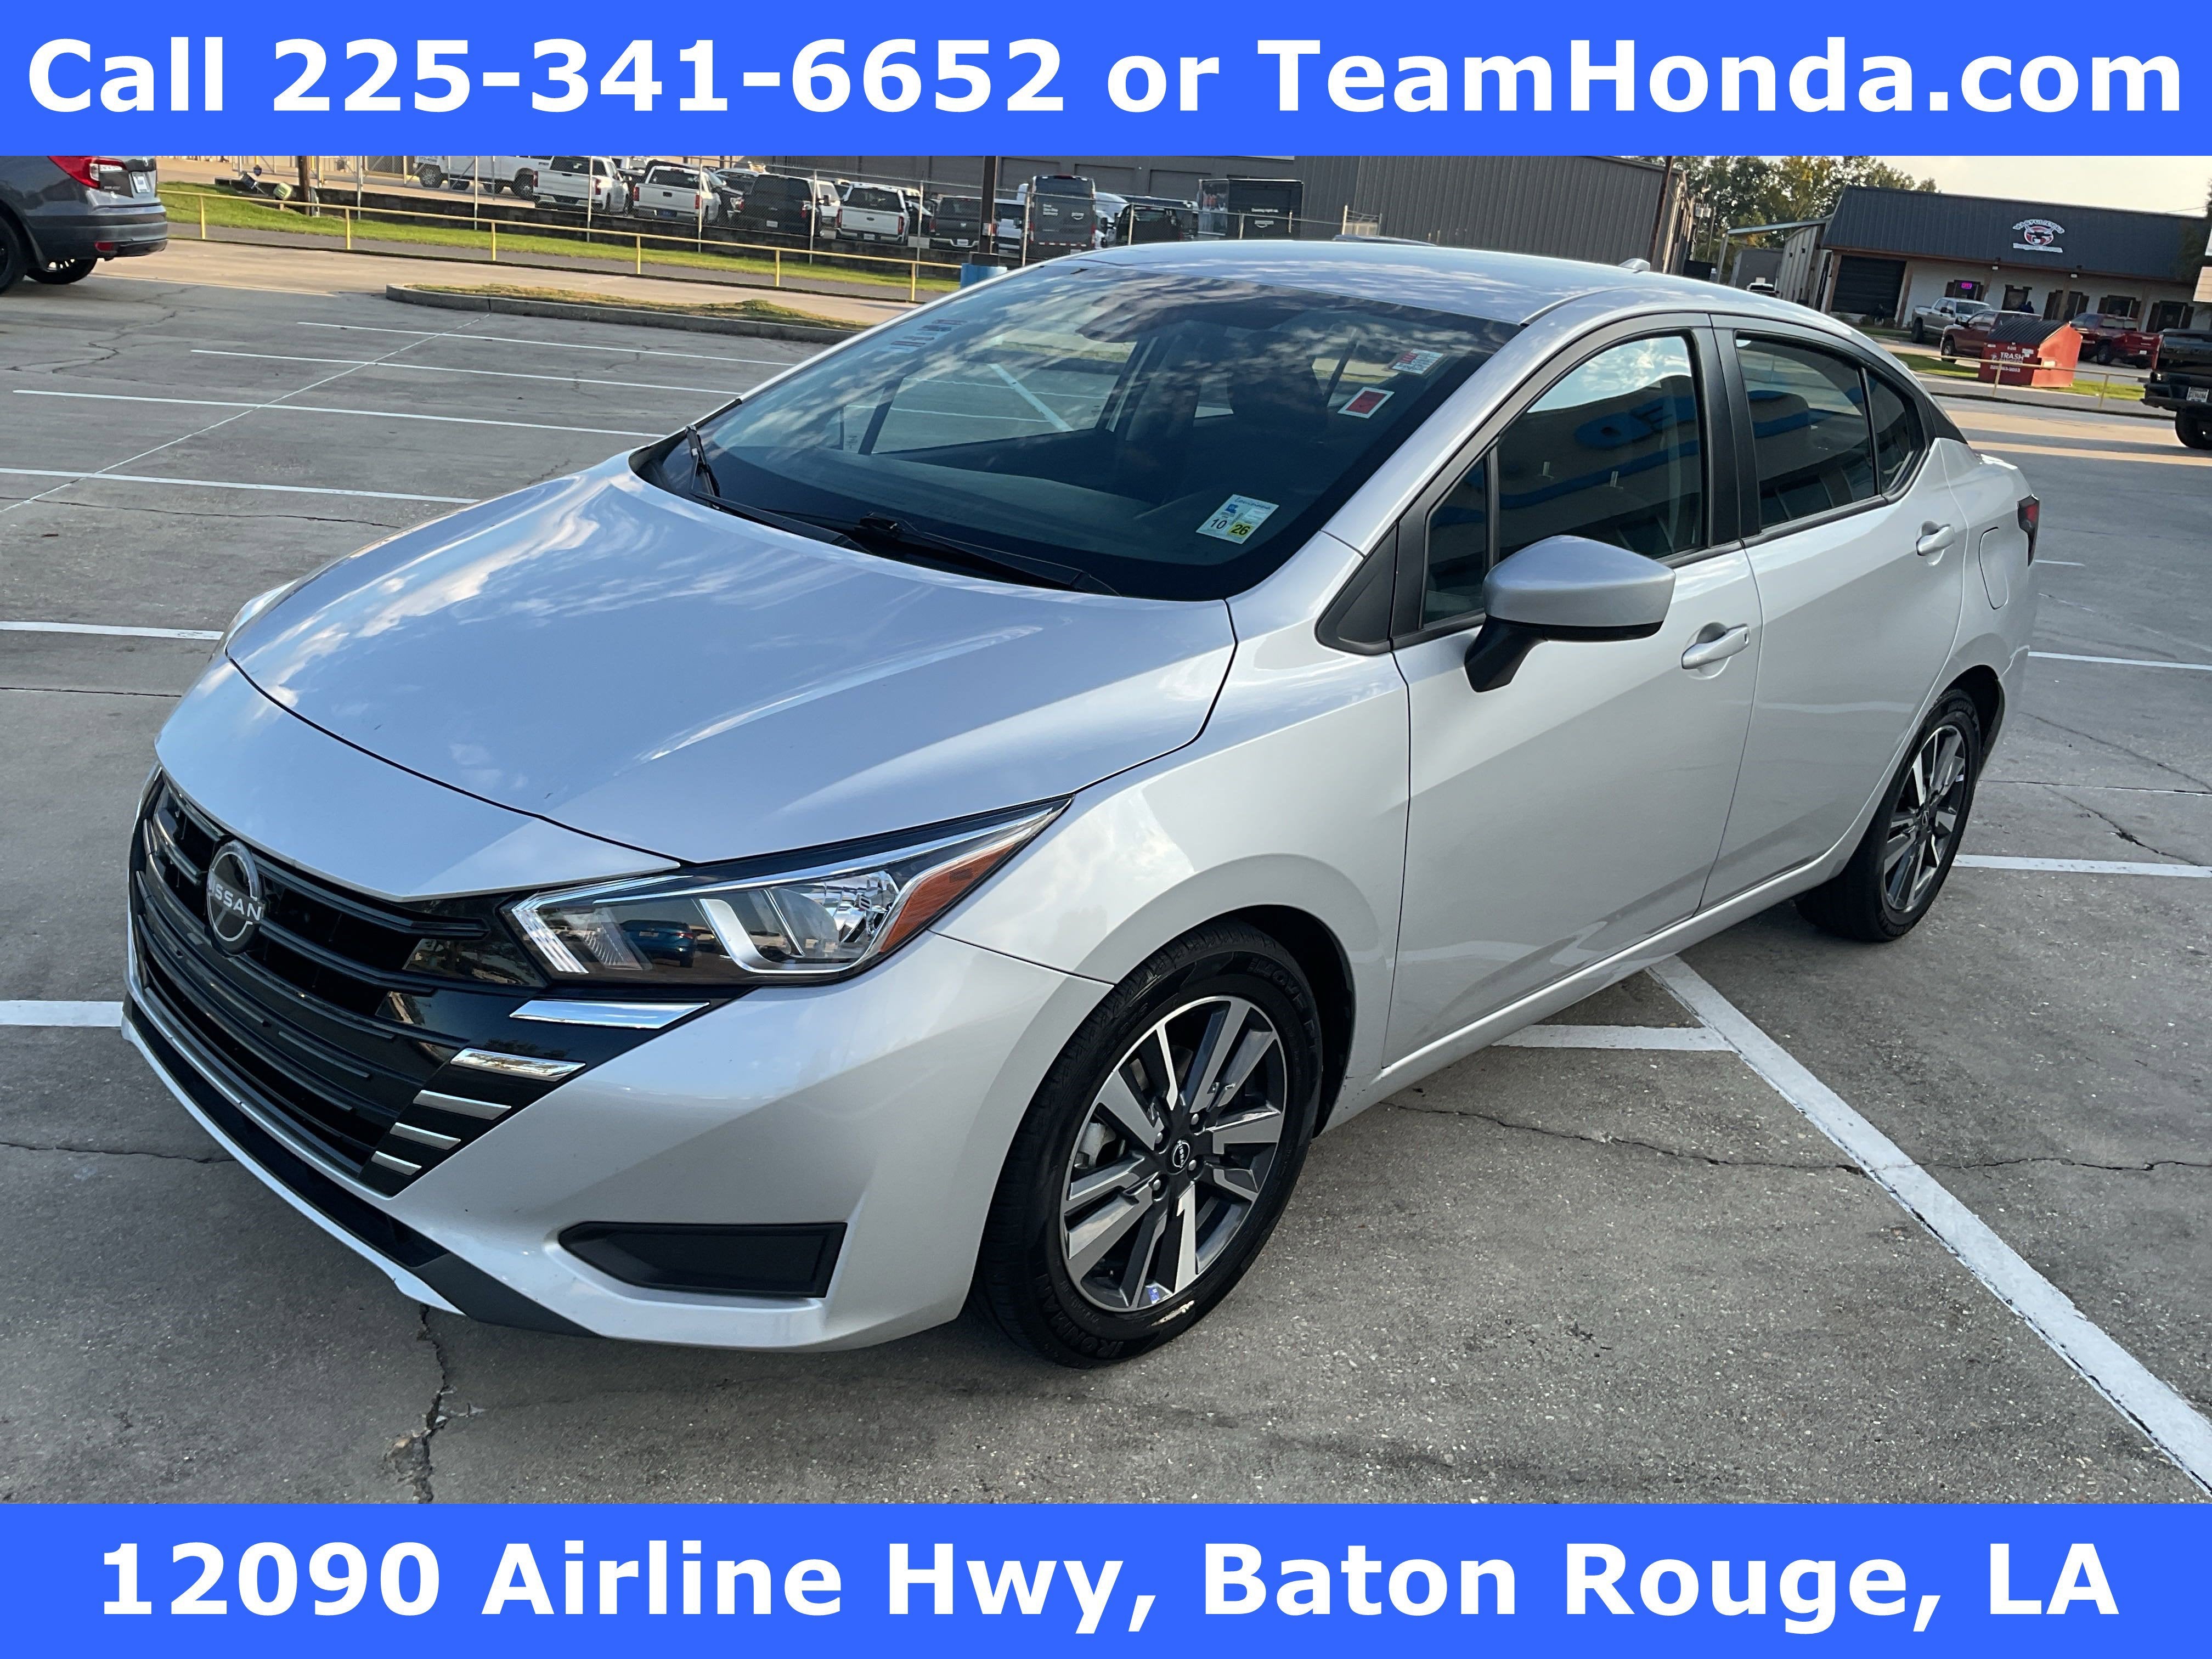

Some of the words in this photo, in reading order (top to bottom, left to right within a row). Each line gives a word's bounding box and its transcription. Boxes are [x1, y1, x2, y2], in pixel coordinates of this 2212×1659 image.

[2000, 352, 2024, 360] TRASH
[1210, 518, 1228, 529] 10
[1231, 524, 1251, 536] 26
